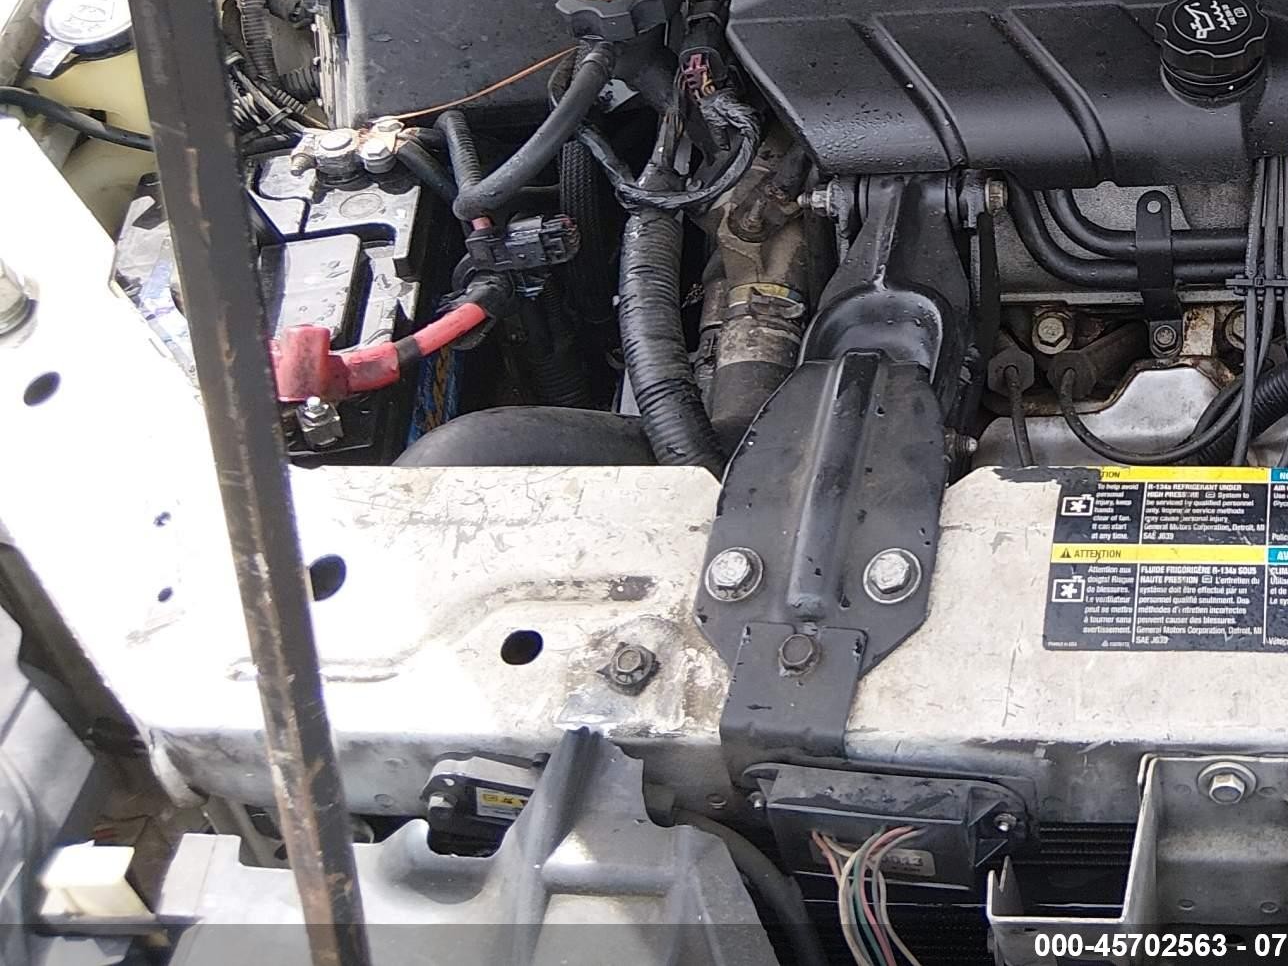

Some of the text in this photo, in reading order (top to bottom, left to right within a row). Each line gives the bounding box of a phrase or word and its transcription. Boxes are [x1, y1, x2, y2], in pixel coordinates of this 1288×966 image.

[1144, 524, 1168, 532] General
[1193, 524, 1231, 532] Corporation,
[1091, 532, 1098, 540] at
[1099, 532, 1111, 540] any
[1074, 550, 1121, 558] ATTENTION
[1141, 566, 1165, 574] FLUIDE
[1238, 566, 1257, 574] SOUS
[1270, 588, 1277, 596] et
[1278, 588, 1287, 596] de
[1139, 596, 1172, 604] personnel
[1270, 597, 1278, 605] Le
[1084, 606, 1100, 614] peut
[1101, 606, 1109, 614] se
[1165, 616, 1188, 624] causer
[1190, 616, 1202, 624] des
[1137, 627, 1161, 635] General
[1163, 627, 1186, 635] Motors
